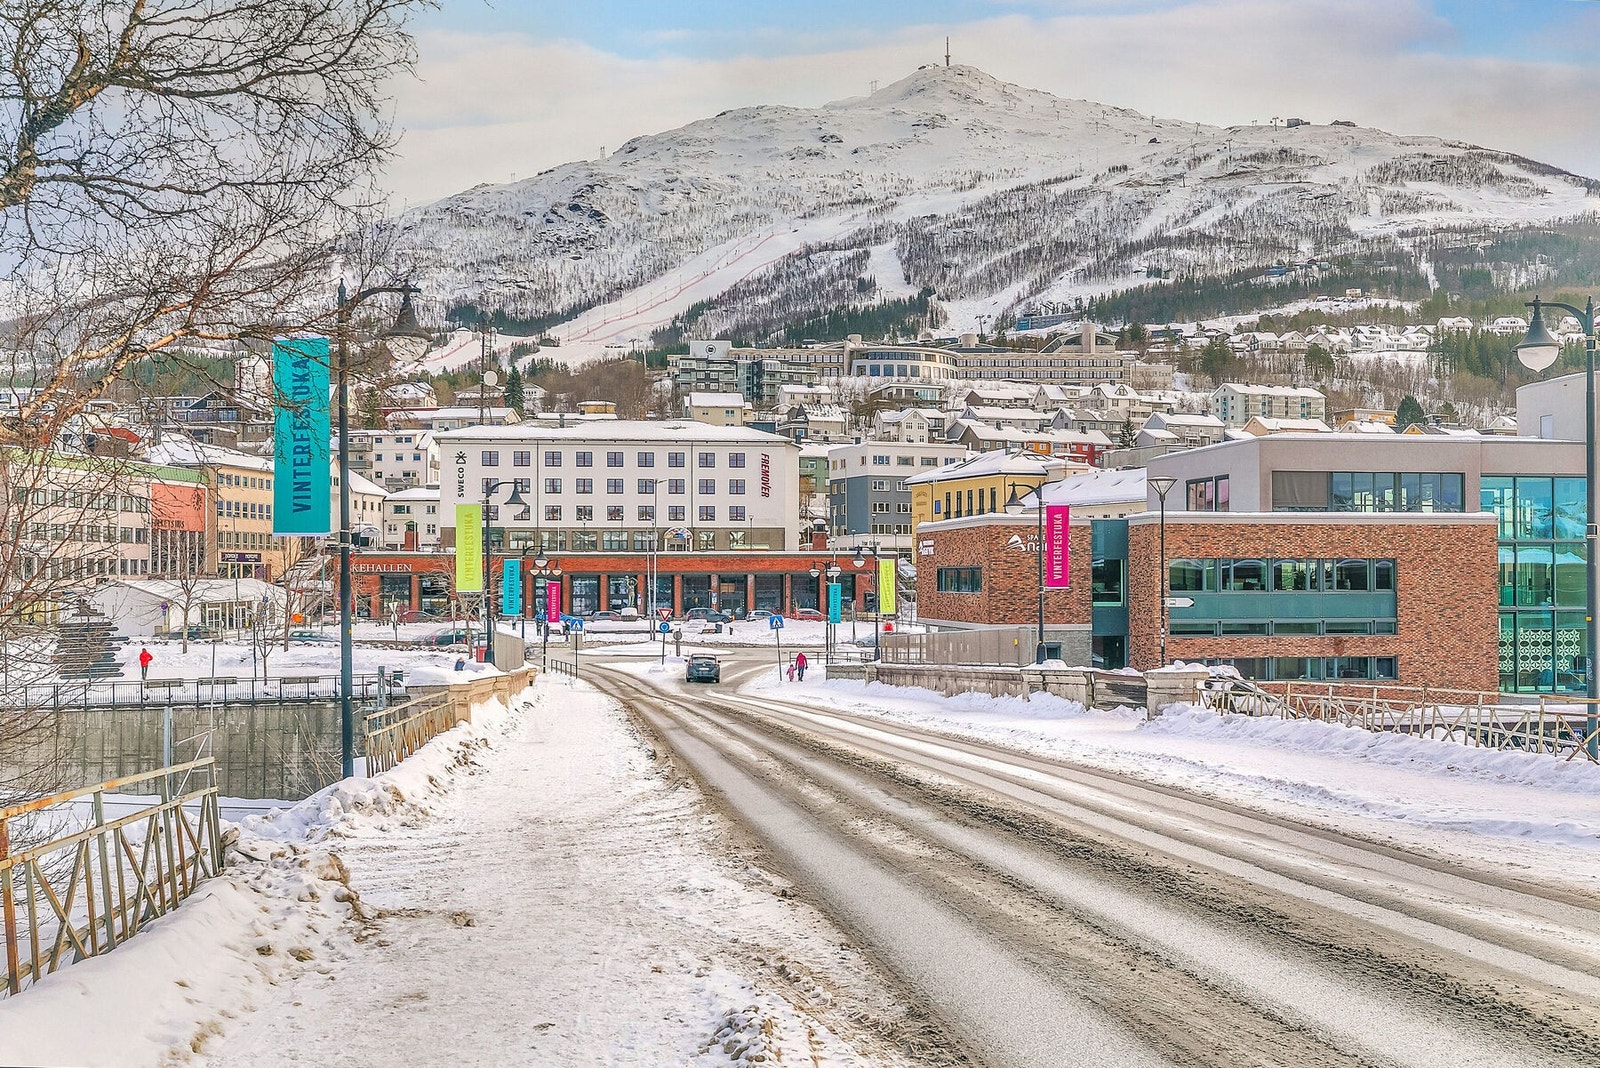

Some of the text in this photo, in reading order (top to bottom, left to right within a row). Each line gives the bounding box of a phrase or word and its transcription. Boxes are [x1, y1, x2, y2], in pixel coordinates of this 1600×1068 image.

[457, 467, 465, 498] SWECO
[760, 452, 771, 498] FREMOVER
[464, 512, 474, 582] VINTERFESTUKA
[1053, 513, 1063, 580] VINTERFESTUKA
